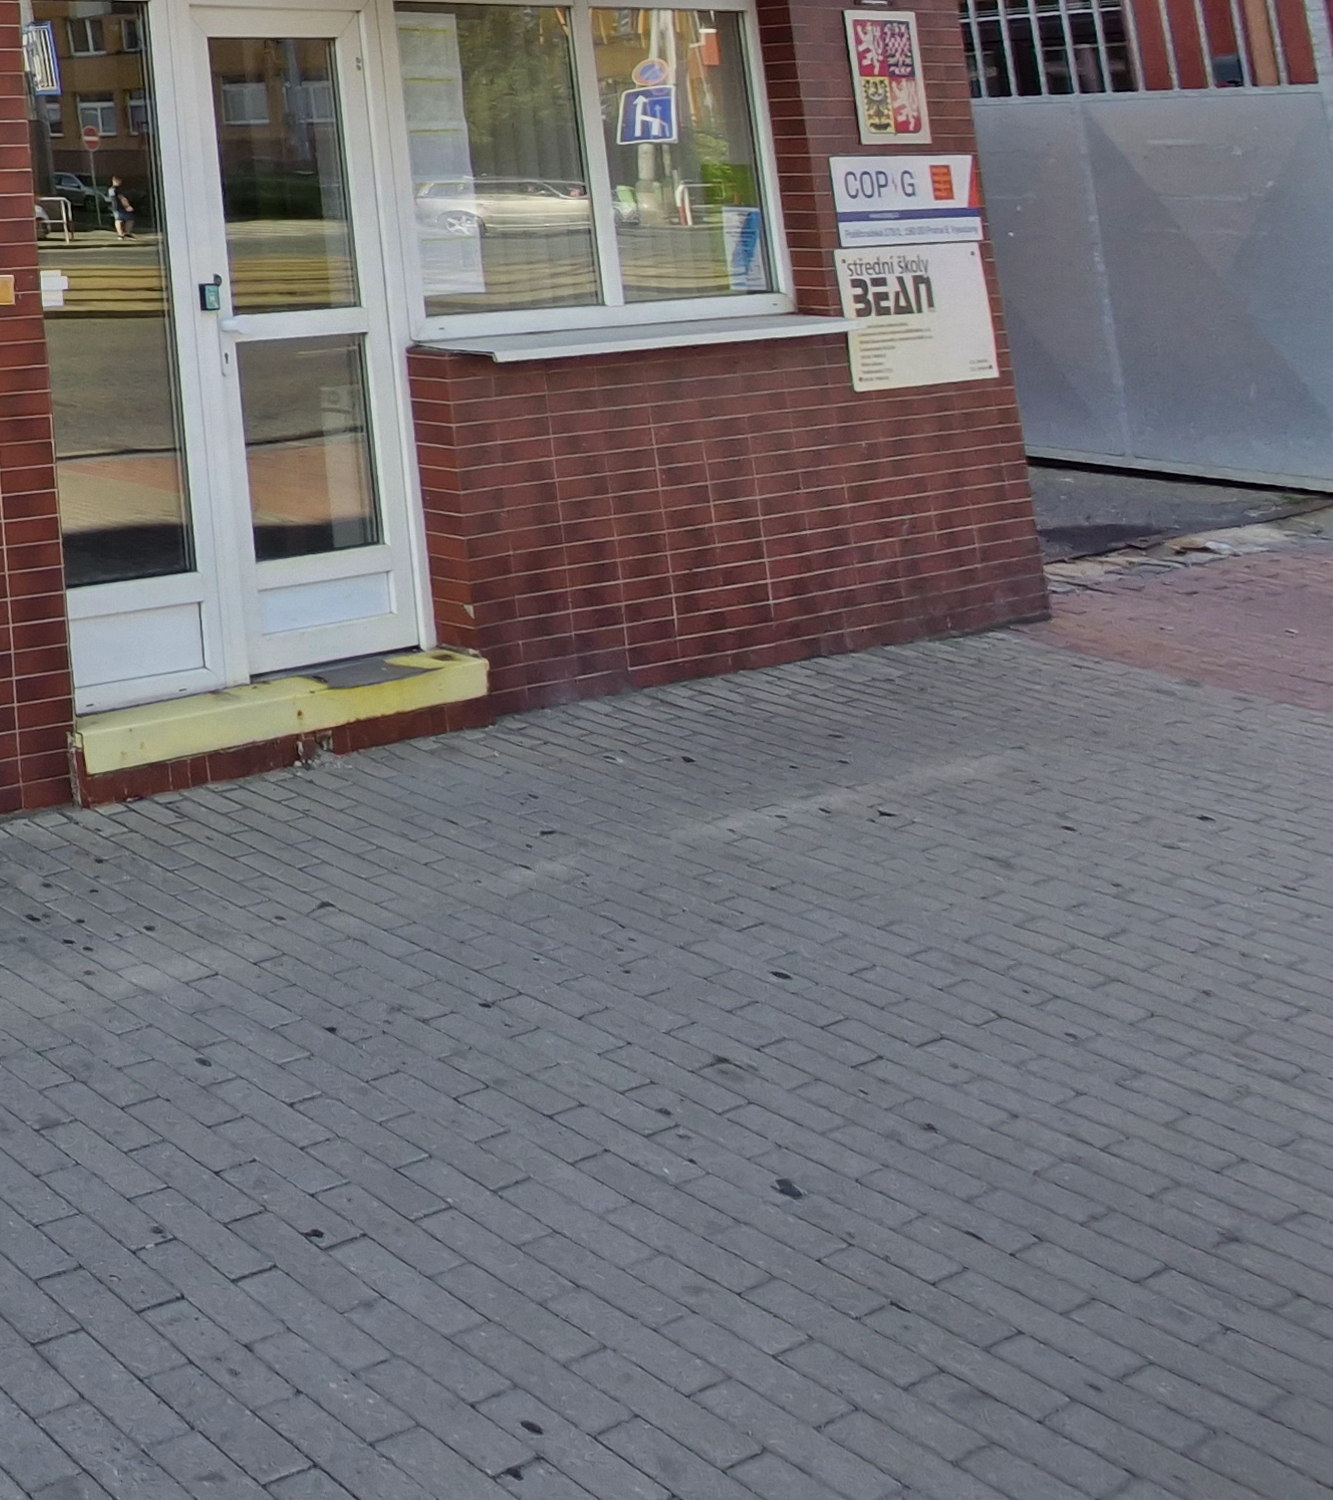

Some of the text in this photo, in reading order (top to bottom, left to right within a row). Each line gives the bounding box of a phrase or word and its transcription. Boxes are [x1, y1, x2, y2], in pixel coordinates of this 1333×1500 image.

[847, 254, 929, 276] střední školy
[850, 275, 935, 317] BEAN
